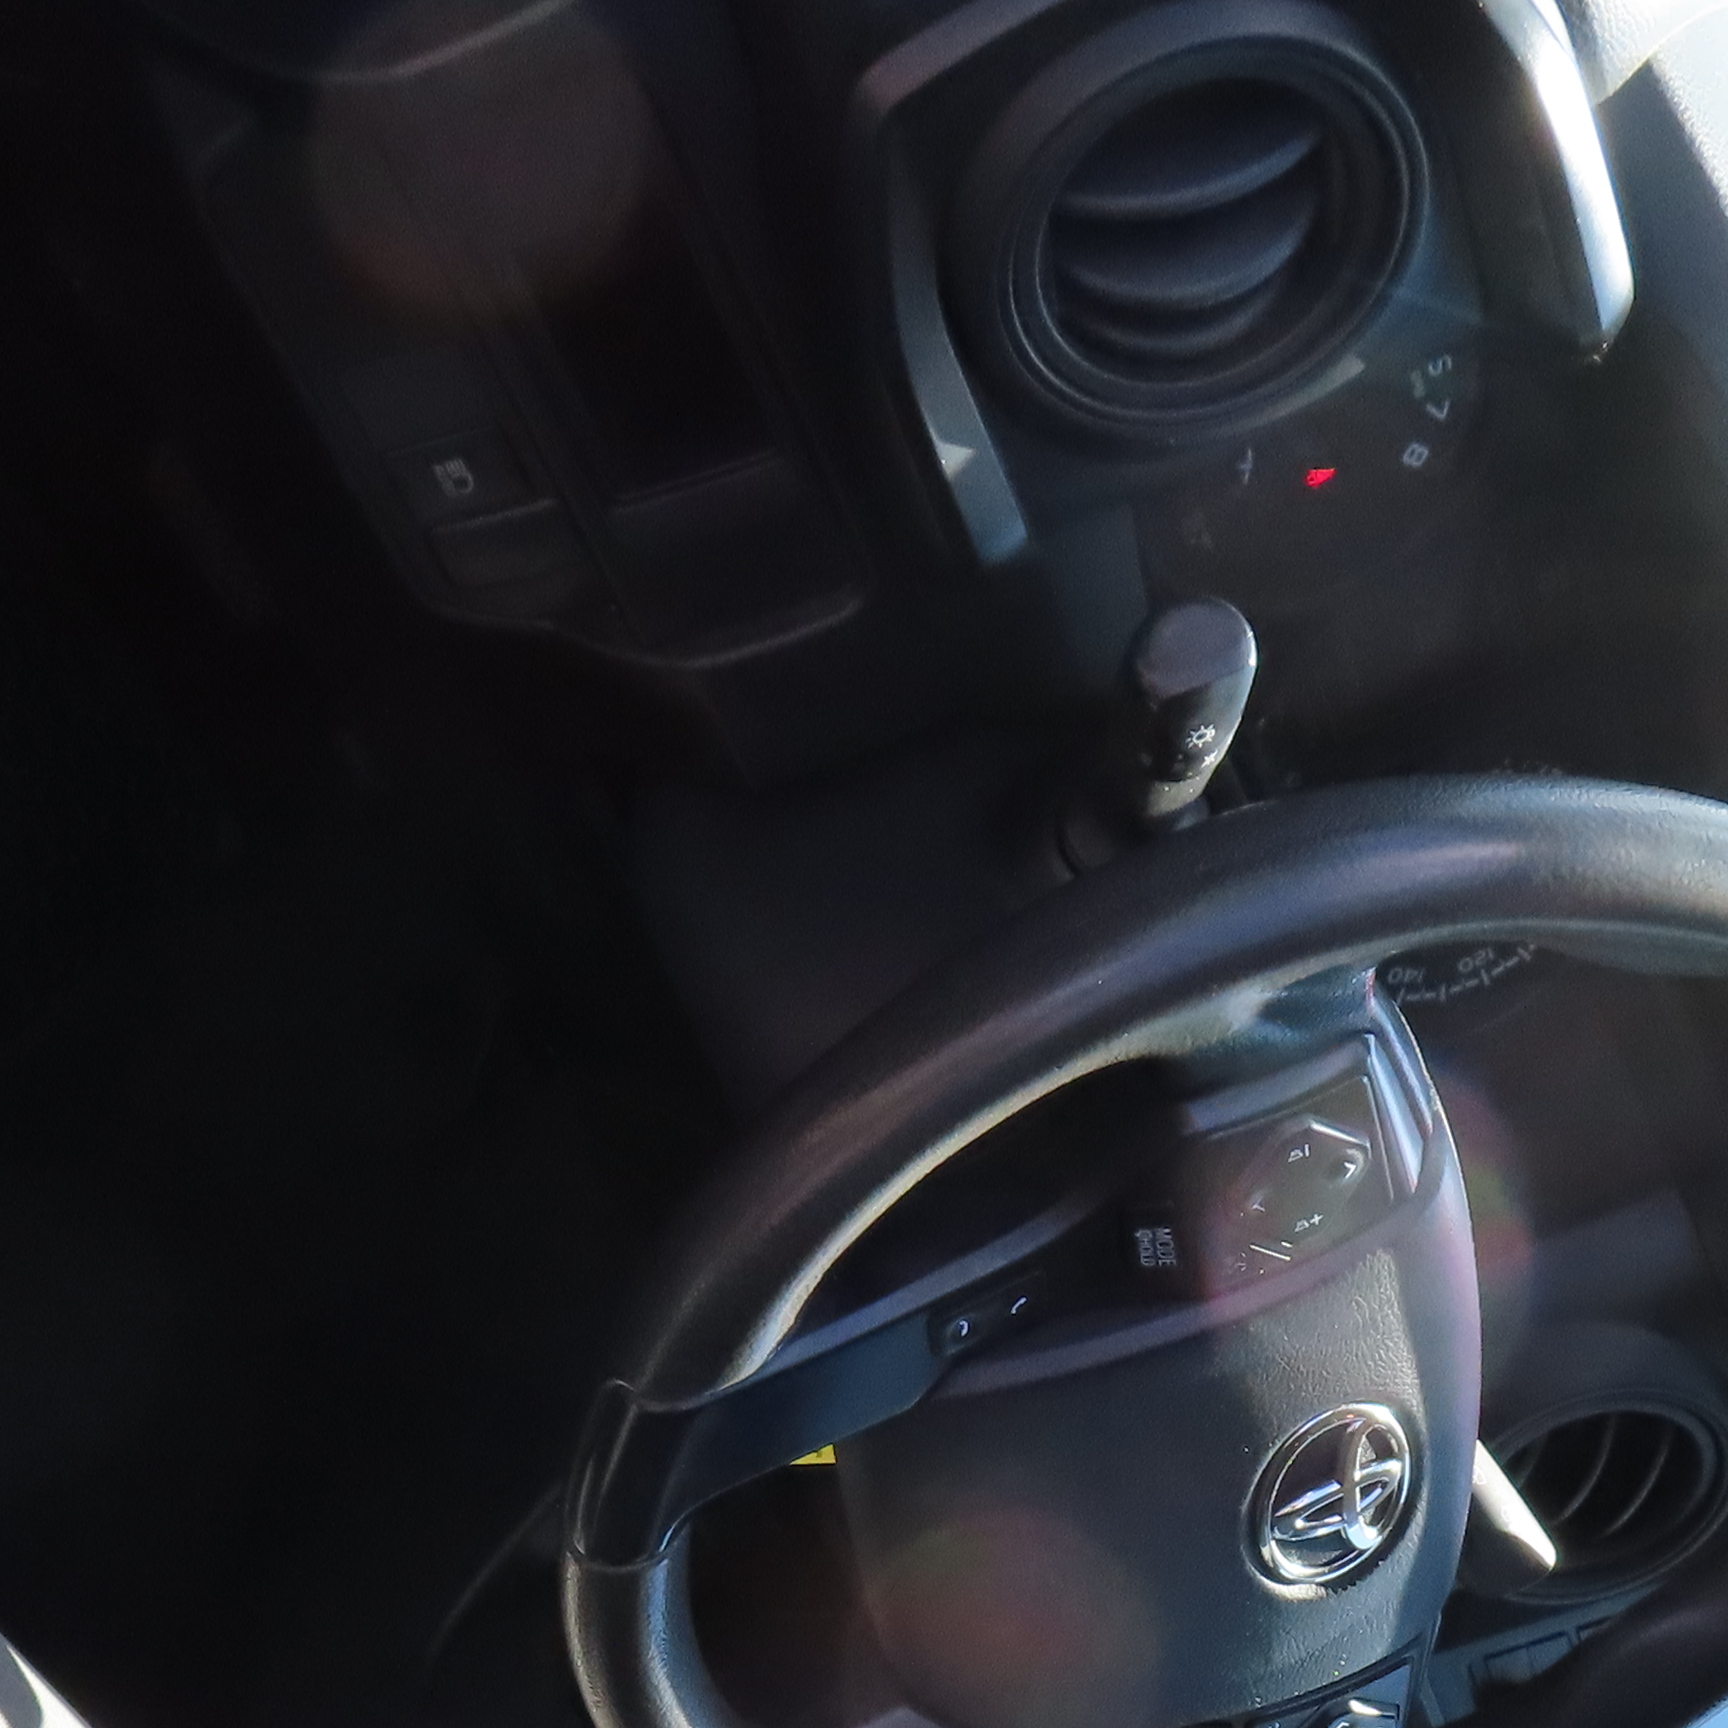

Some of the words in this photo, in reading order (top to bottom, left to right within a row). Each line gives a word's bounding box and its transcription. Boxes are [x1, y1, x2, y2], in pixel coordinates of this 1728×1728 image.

[1426, 400, 1450, 419] 7
[1402, 443, 1429, 466] 8
[1457, 947, 1494, 974] 120
[1156, 1228, 1177, 1266] MODE
